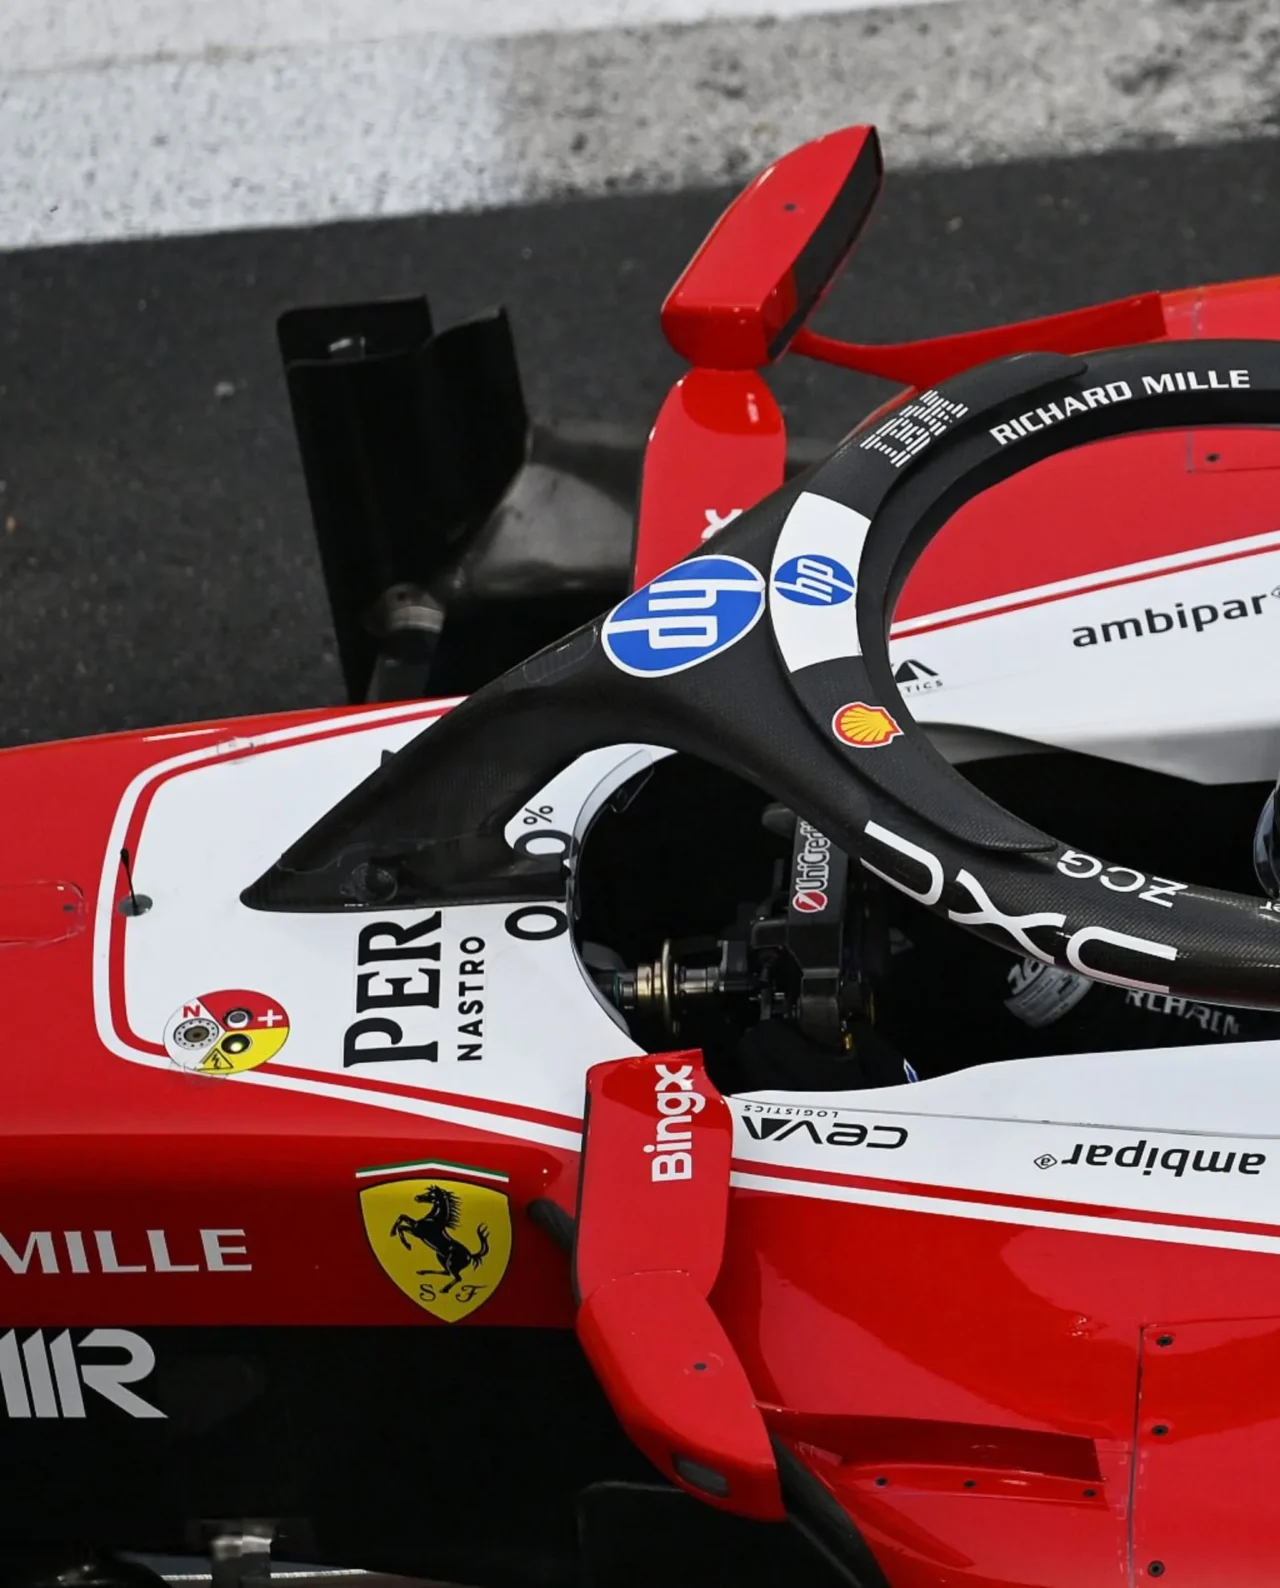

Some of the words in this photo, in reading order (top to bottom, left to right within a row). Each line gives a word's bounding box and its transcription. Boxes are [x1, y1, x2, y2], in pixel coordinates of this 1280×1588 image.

[860, 389, 969, 468] IBM
[989, 379, 1132, 446] RICHARD
[1141, 369, 1251, 396] MILLE
[773, 557, 855, 603] hp
[604, 575, 765, 652] hp
[1071, 592, 1268, 647] ambipar
[183, 1005, 200, 1018] N
[343, 910, 442, 1068] PER
[457, 936, 485, 1061] NASTRO
[743, 1104, 838, 1118] LOGISTICS
[1061, 1140, 1266, 1177] ambipar
[0, 1229, 252, 1274] MILLE
